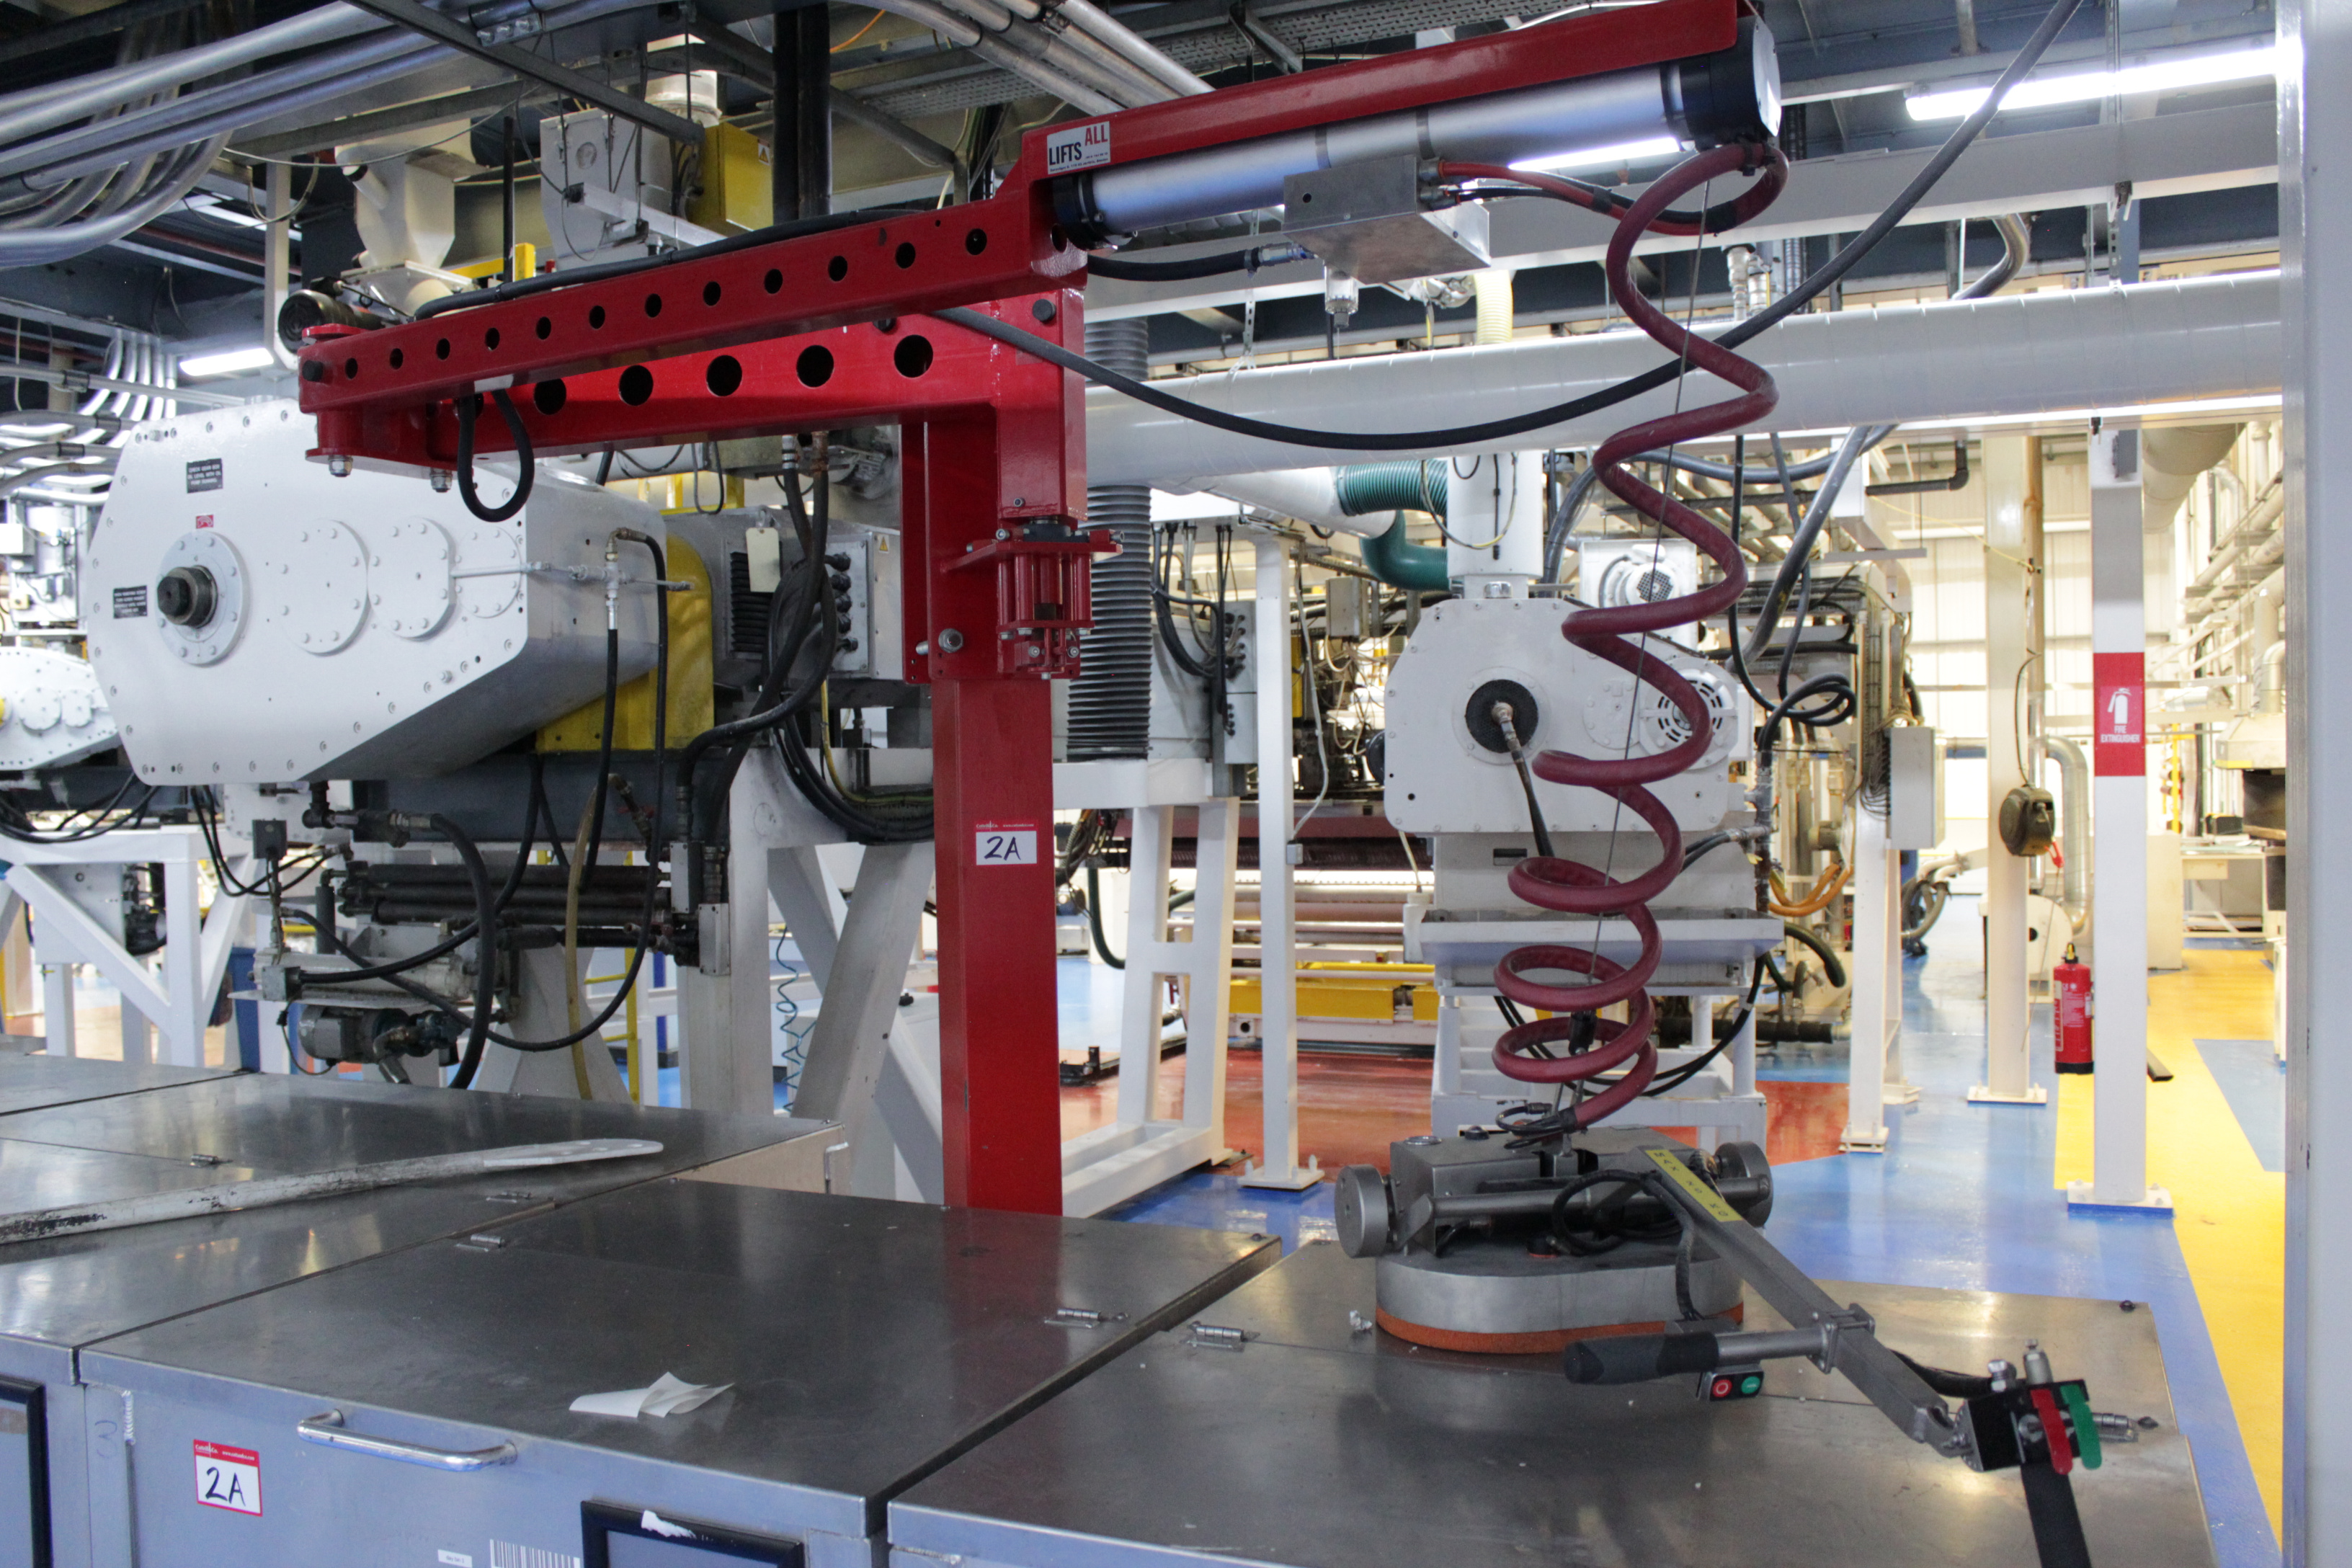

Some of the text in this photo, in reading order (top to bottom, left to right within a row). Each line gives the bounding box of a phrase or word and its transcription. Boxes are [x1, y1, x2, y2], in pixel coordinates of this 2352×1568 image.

[1049, 124, 1108, 166] LIFTS ALL
[2100, 725, 2140, 743] FIRE EXTINGUISHER
[984, 836, 1021, 861] 2A
[205, 1466, 246, 1507] 2A
